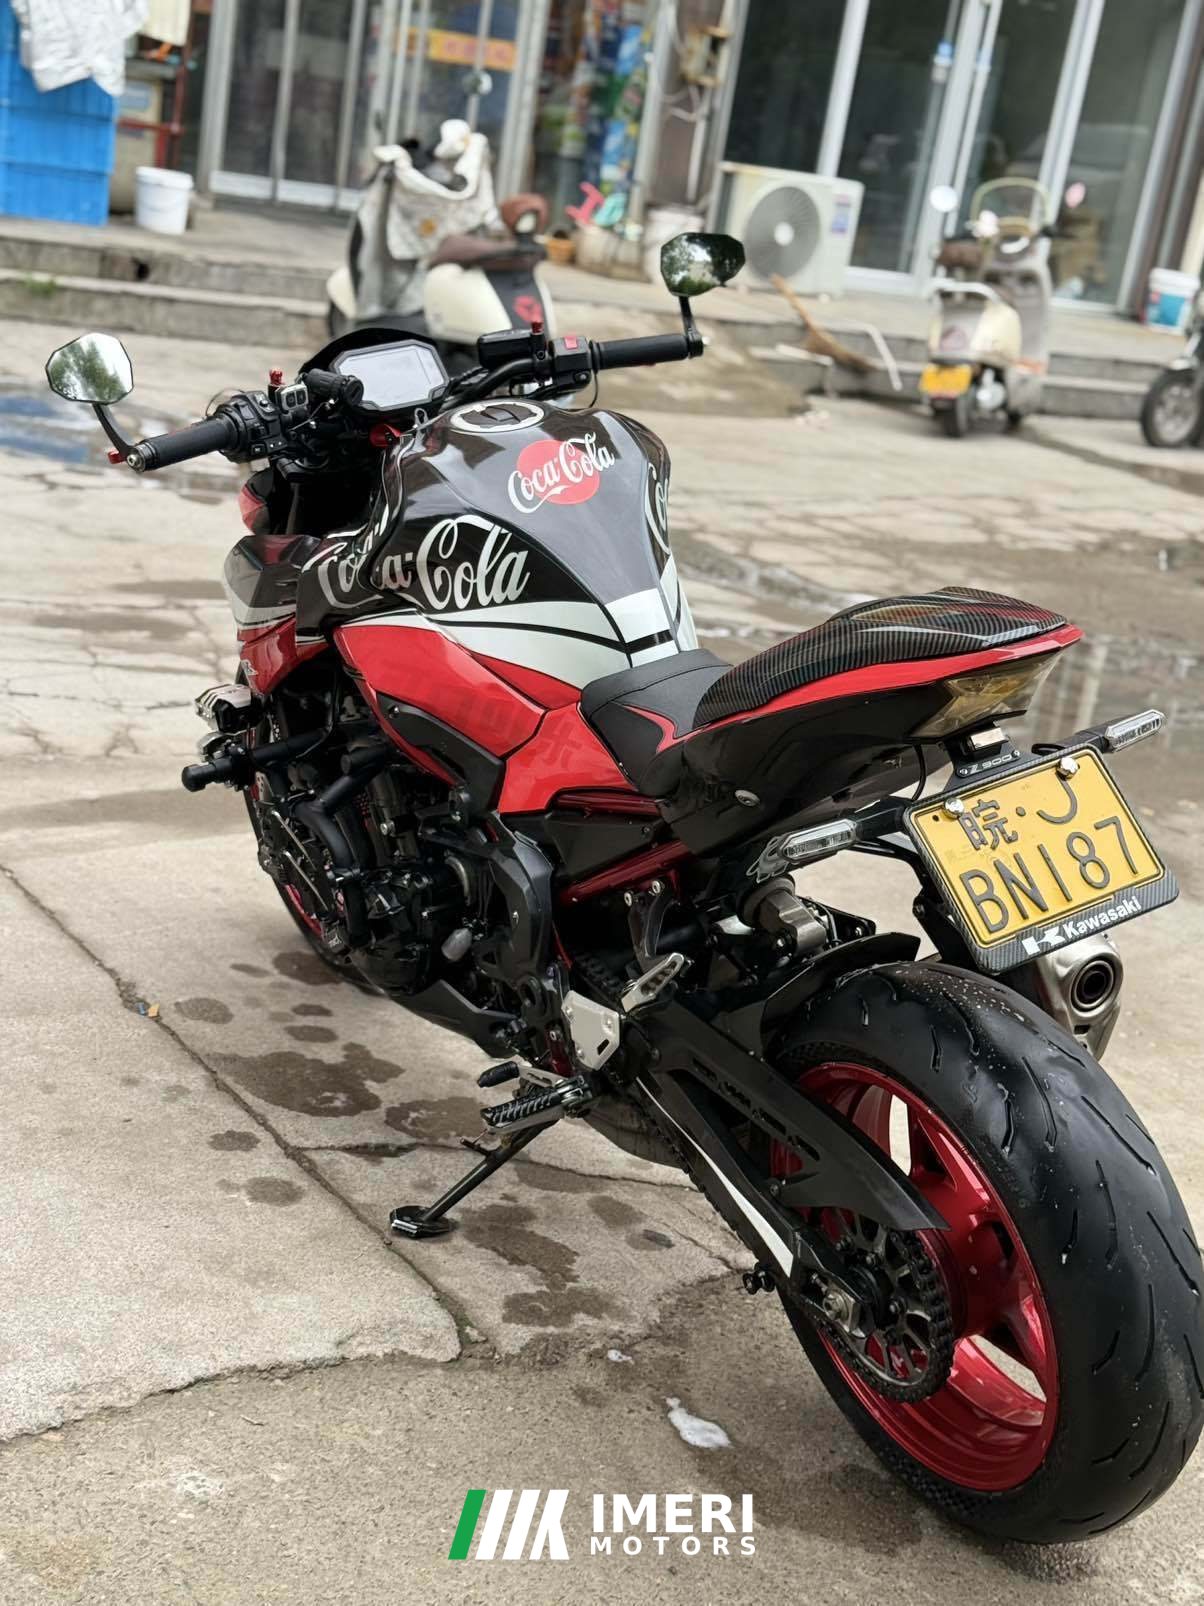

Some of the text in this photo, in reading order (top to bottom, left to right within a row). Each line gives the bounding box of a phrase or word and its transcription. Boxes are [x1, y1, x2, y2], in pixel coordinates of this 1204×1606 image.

[507, 432, 615, 513] Coca-Cola
[959, 815, 1138, 933] BN187
[1061, 895, 1142, 940] Kawasaki
